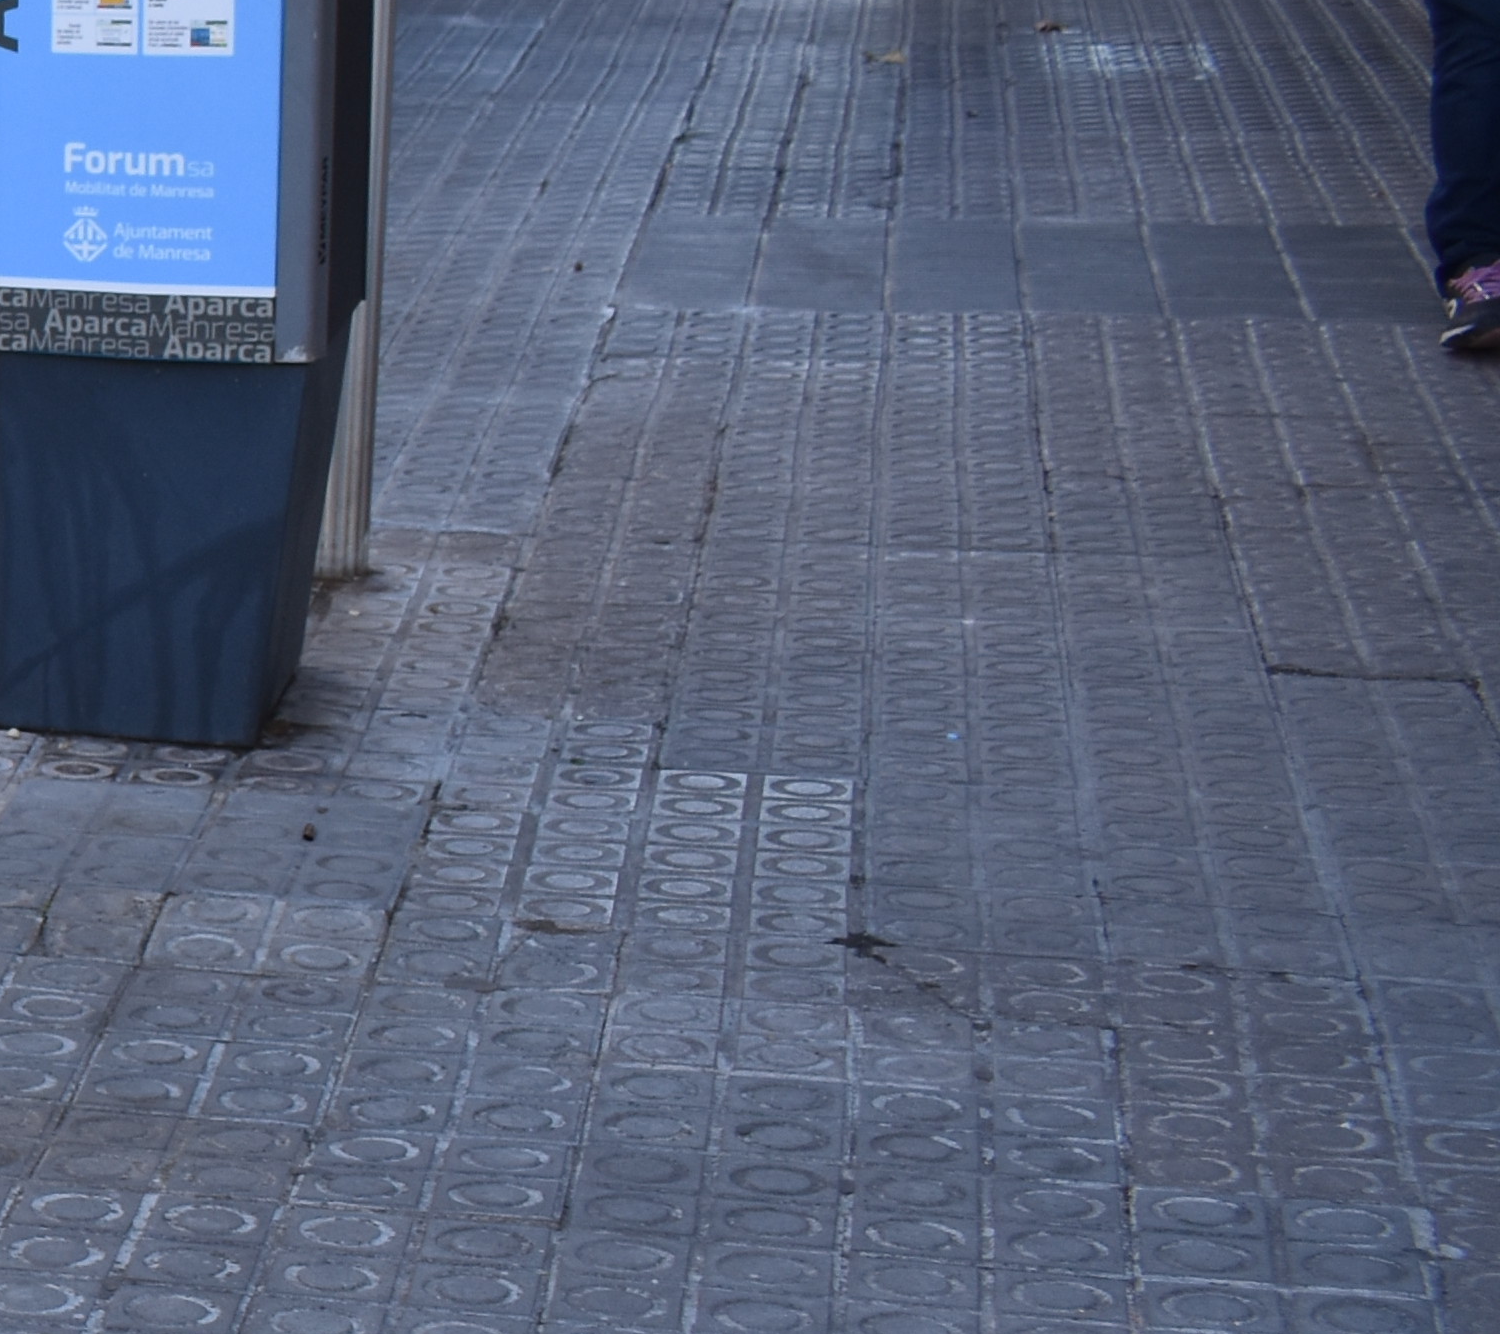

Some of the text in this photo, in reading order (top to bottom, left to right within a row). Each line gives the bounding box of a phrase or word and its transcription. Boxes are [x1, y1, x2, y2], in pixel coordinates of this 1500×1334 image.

[63, 142, 185, 177] Forum
[65, 180, 215, 199] Mobilitat de Manresa
[113, 222, 213, 243] Ajuntament
[113, 243, 211, 261] de Manresa
